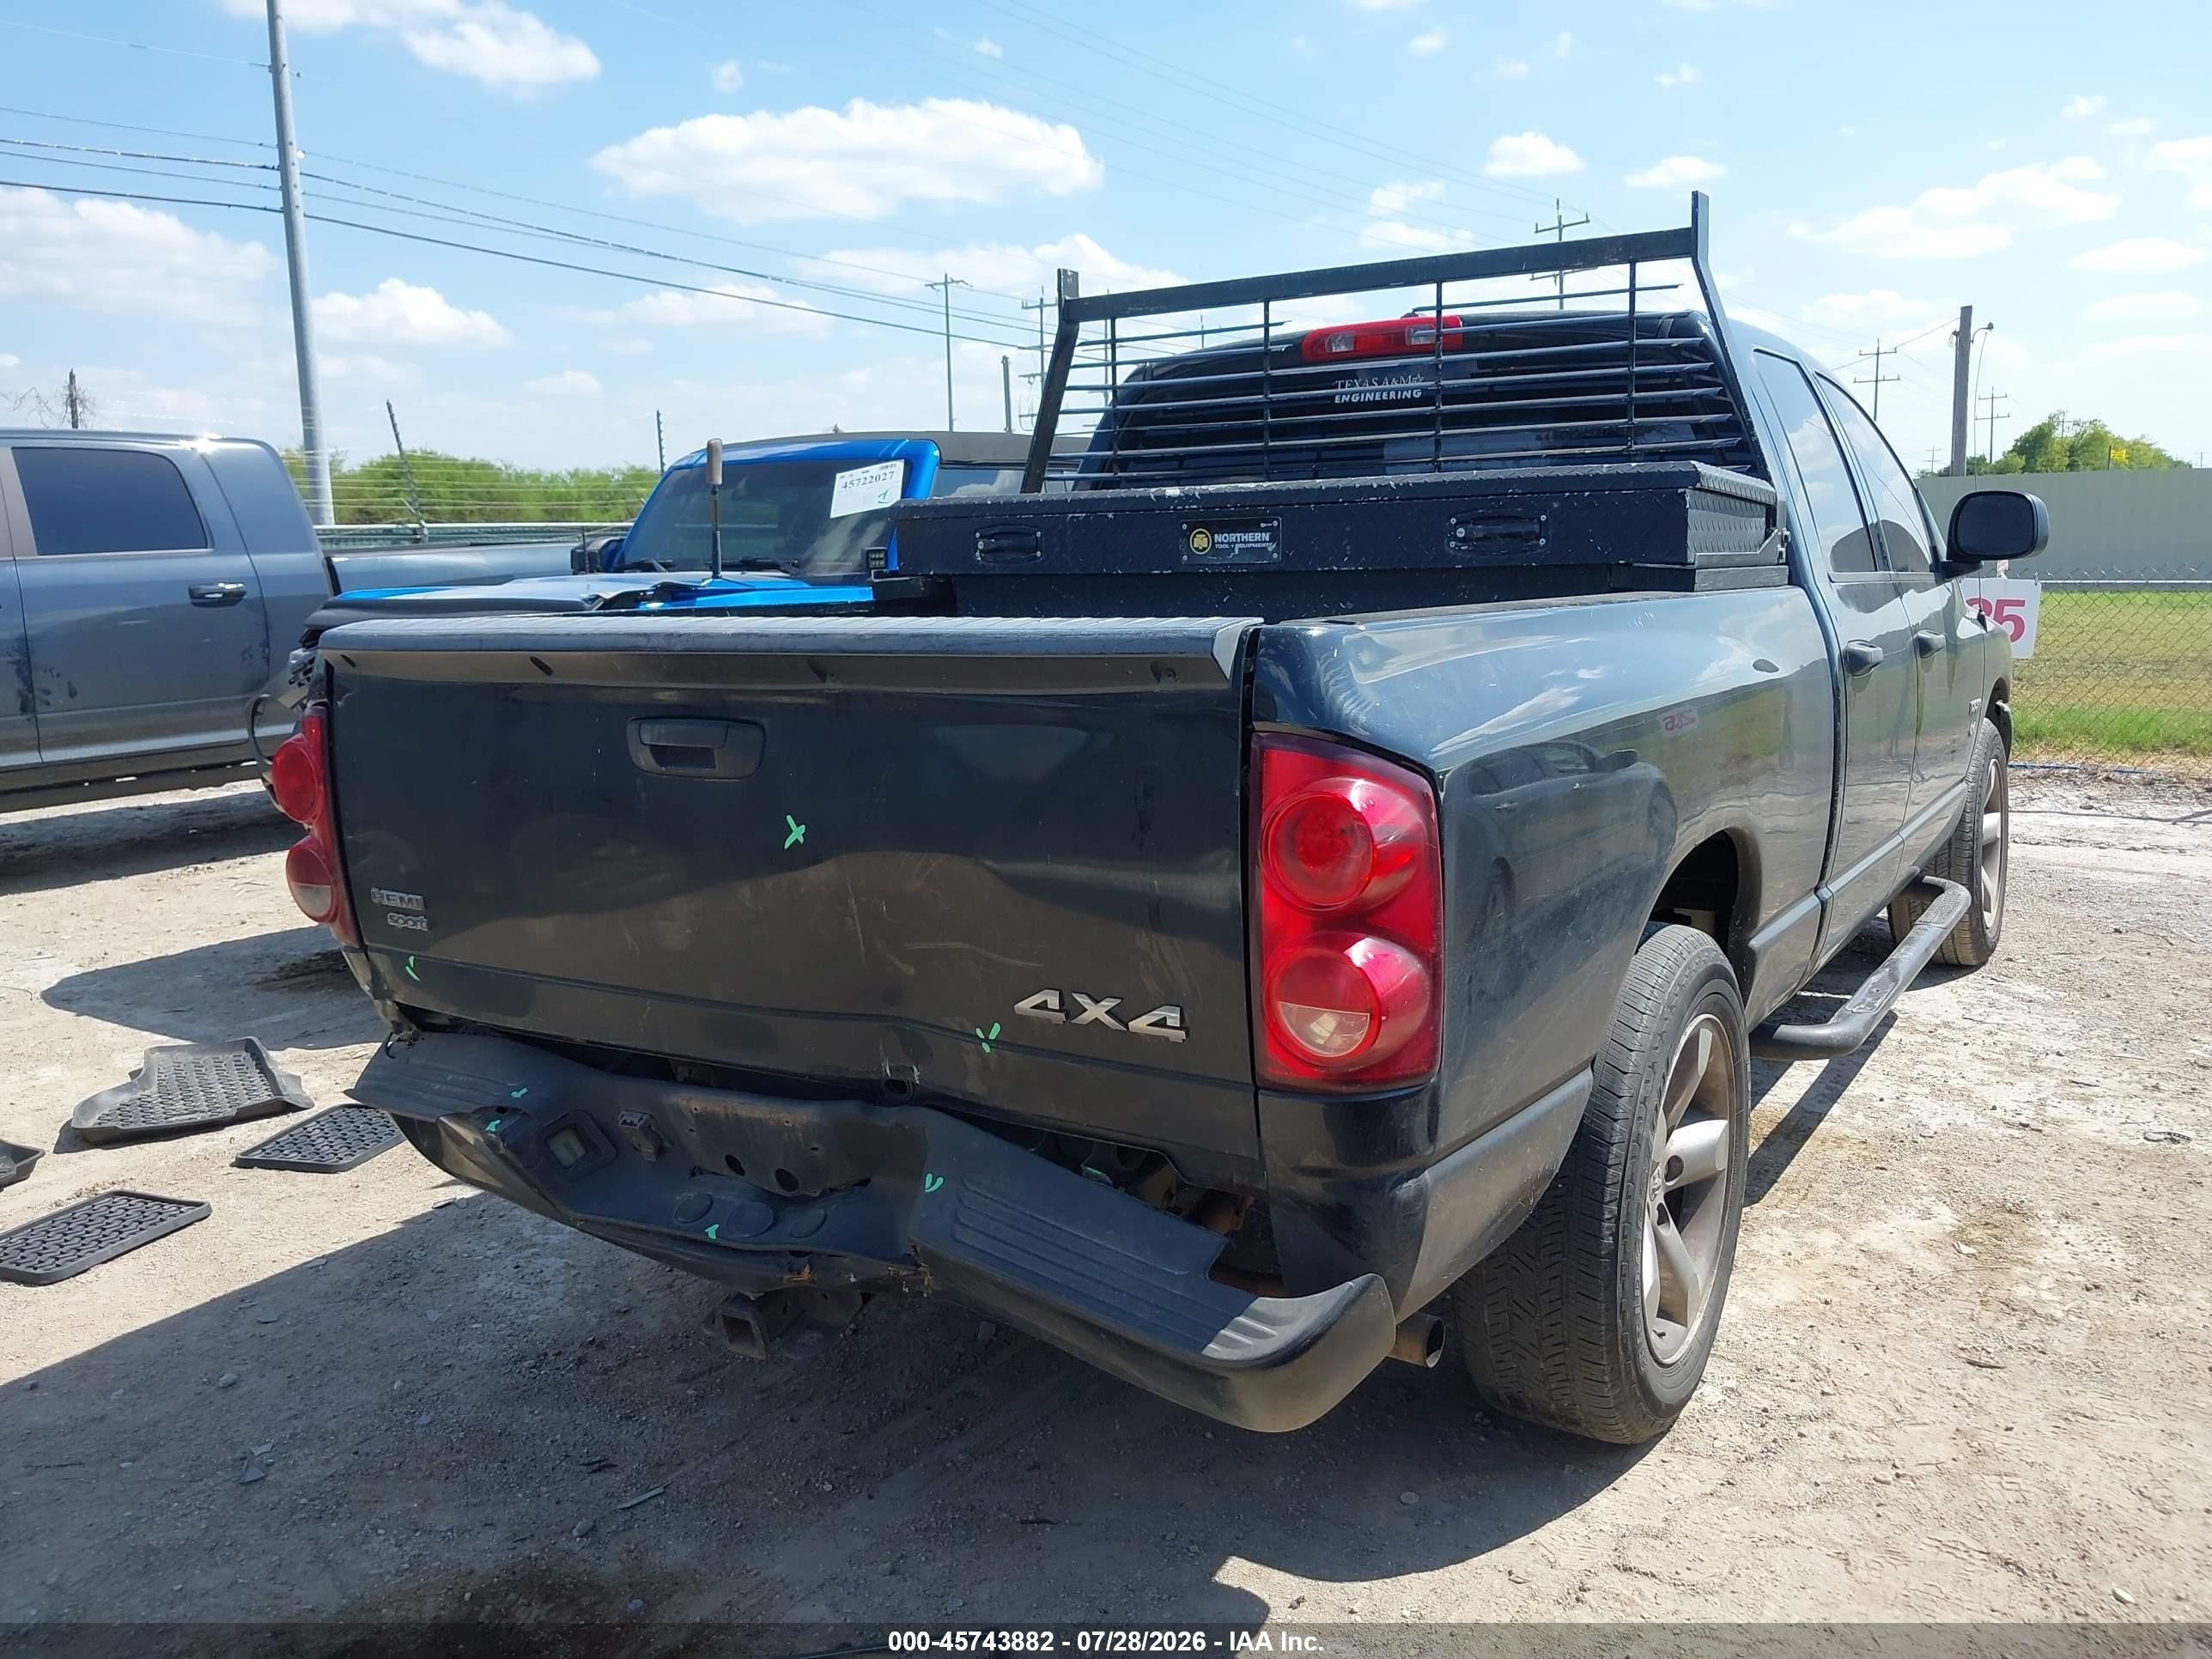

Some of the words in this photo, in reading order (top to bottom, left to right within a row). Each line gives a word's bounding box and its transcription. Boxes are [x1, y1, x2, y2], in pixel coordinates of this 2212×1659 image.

[1334, 377, 1379, 390] TEXAS
[1334, 389, 1423, 404] ENGINEERING
[842, 471, 895, 489] 45722027
[1214, 532, 1271, 544] NORTHERN
